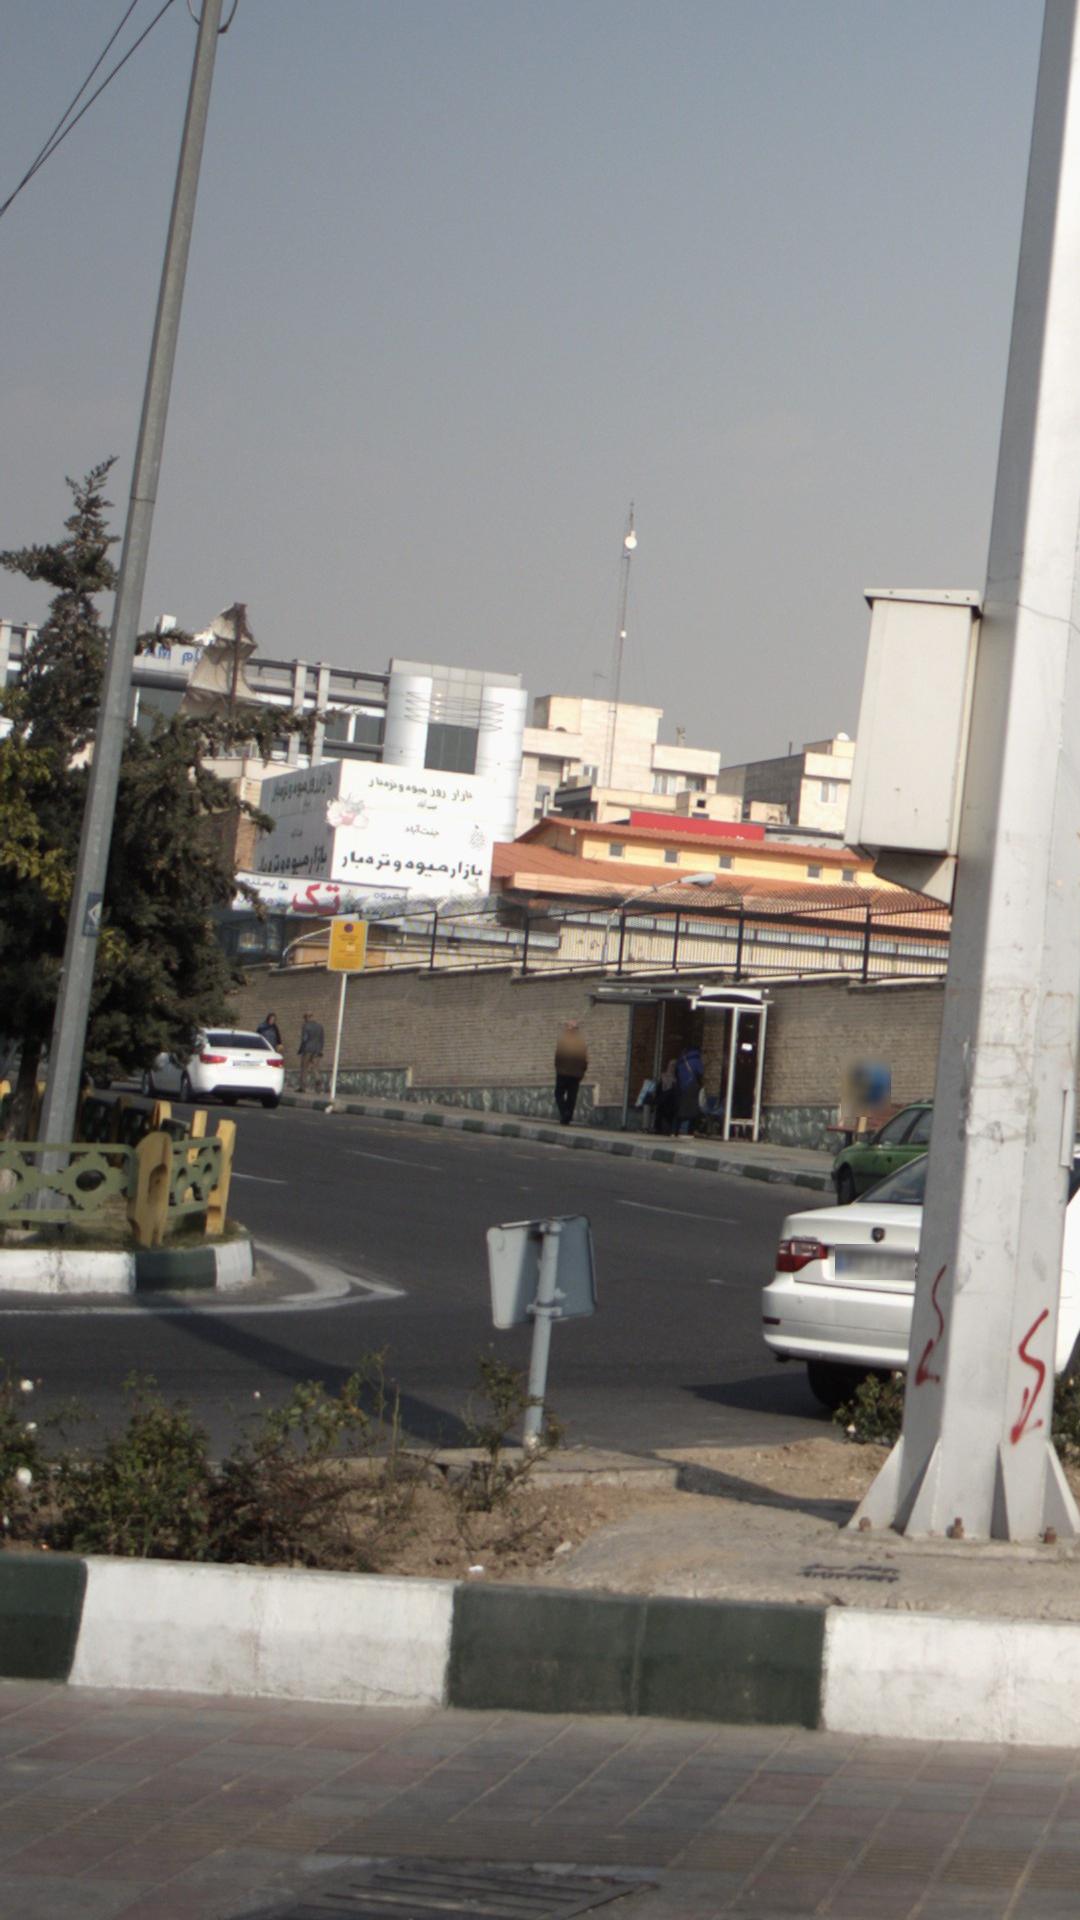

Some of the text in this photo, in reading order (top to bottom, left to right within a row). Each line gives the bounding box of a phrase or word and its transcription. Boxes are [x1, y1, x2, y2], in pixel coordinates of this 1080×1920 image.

[405, 784, 428, 795] میوه
[430, 786, 447, 799] روز
[451, 788, 473, 802] بازار
[393, 859, 402, 872] و
[405, 860, 448, 877] میوه
[450, 861, 484, 881] بازار
[292, 882, 340, 915] تک
